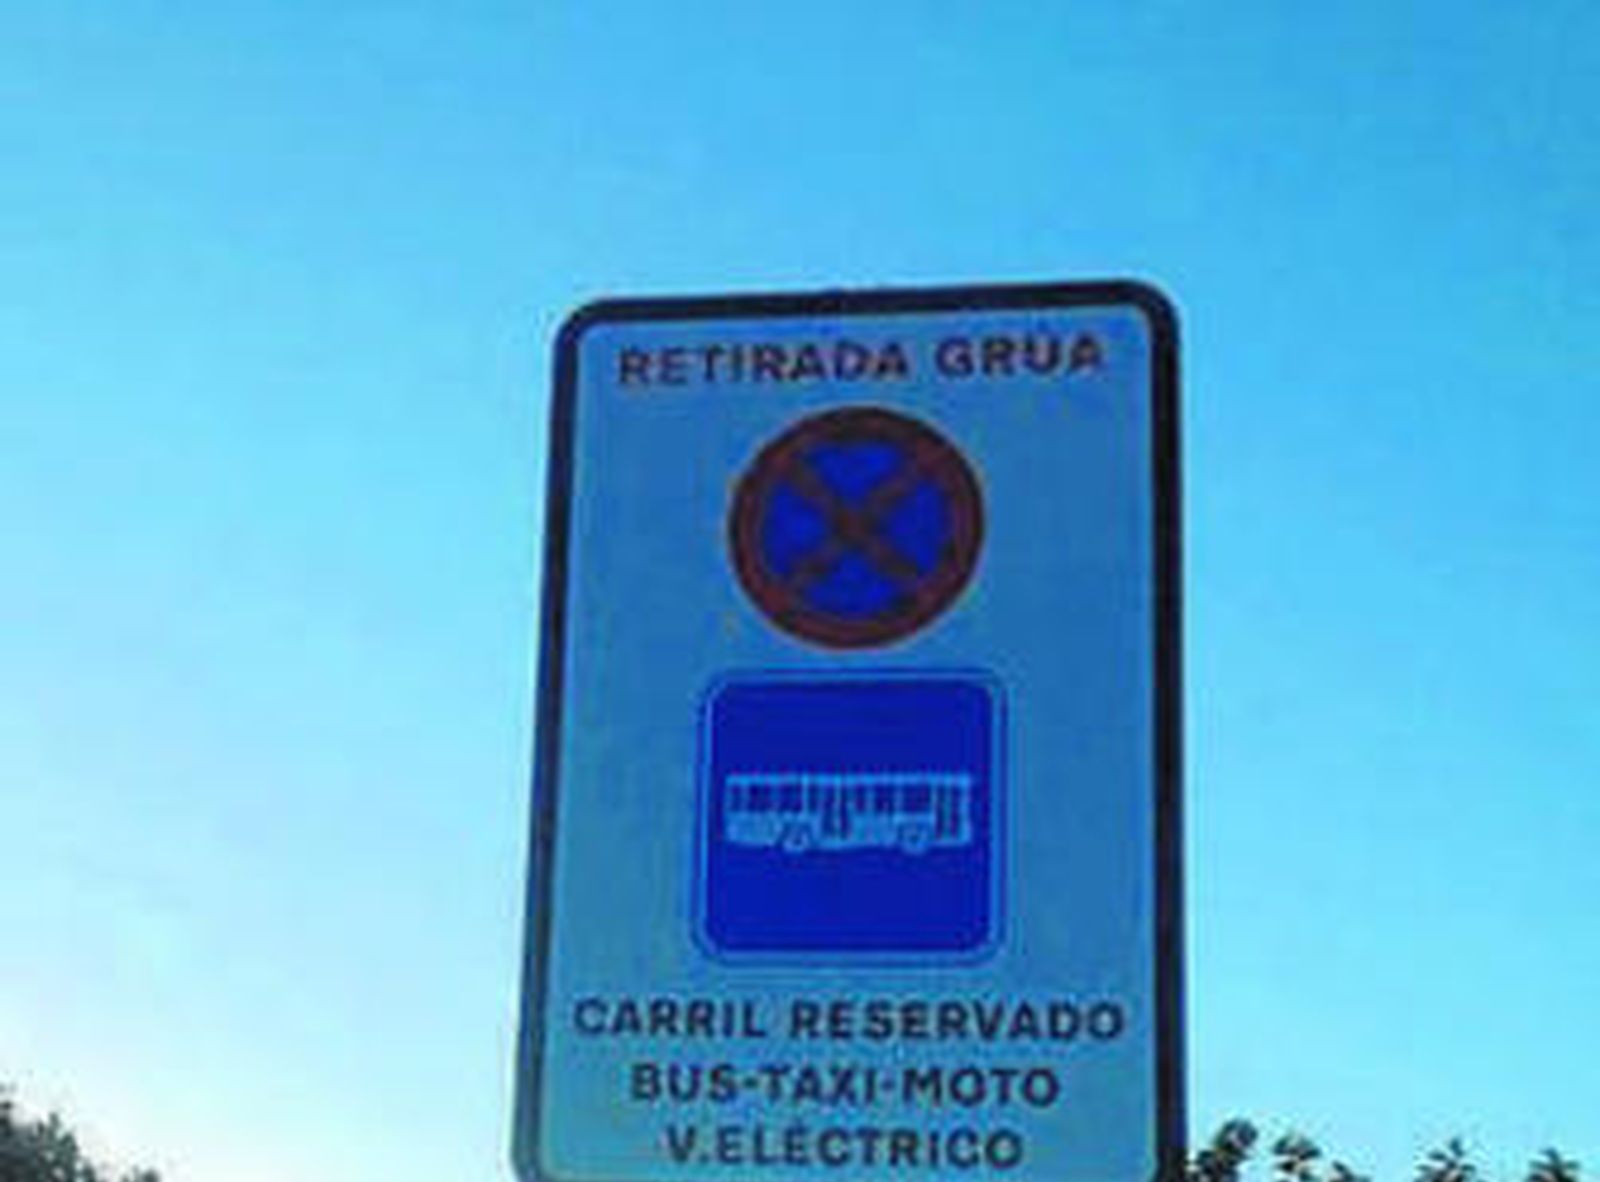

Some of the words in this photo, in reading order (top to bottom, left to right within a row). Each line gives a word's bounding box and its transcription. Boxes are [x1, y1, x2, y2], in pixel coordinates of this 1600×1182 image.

[617, 342, 910, 385] RETIRADA
[573, 998, 767, 1037] CARRIL
[791, 1001, 1125, 1042] RESERVADO
